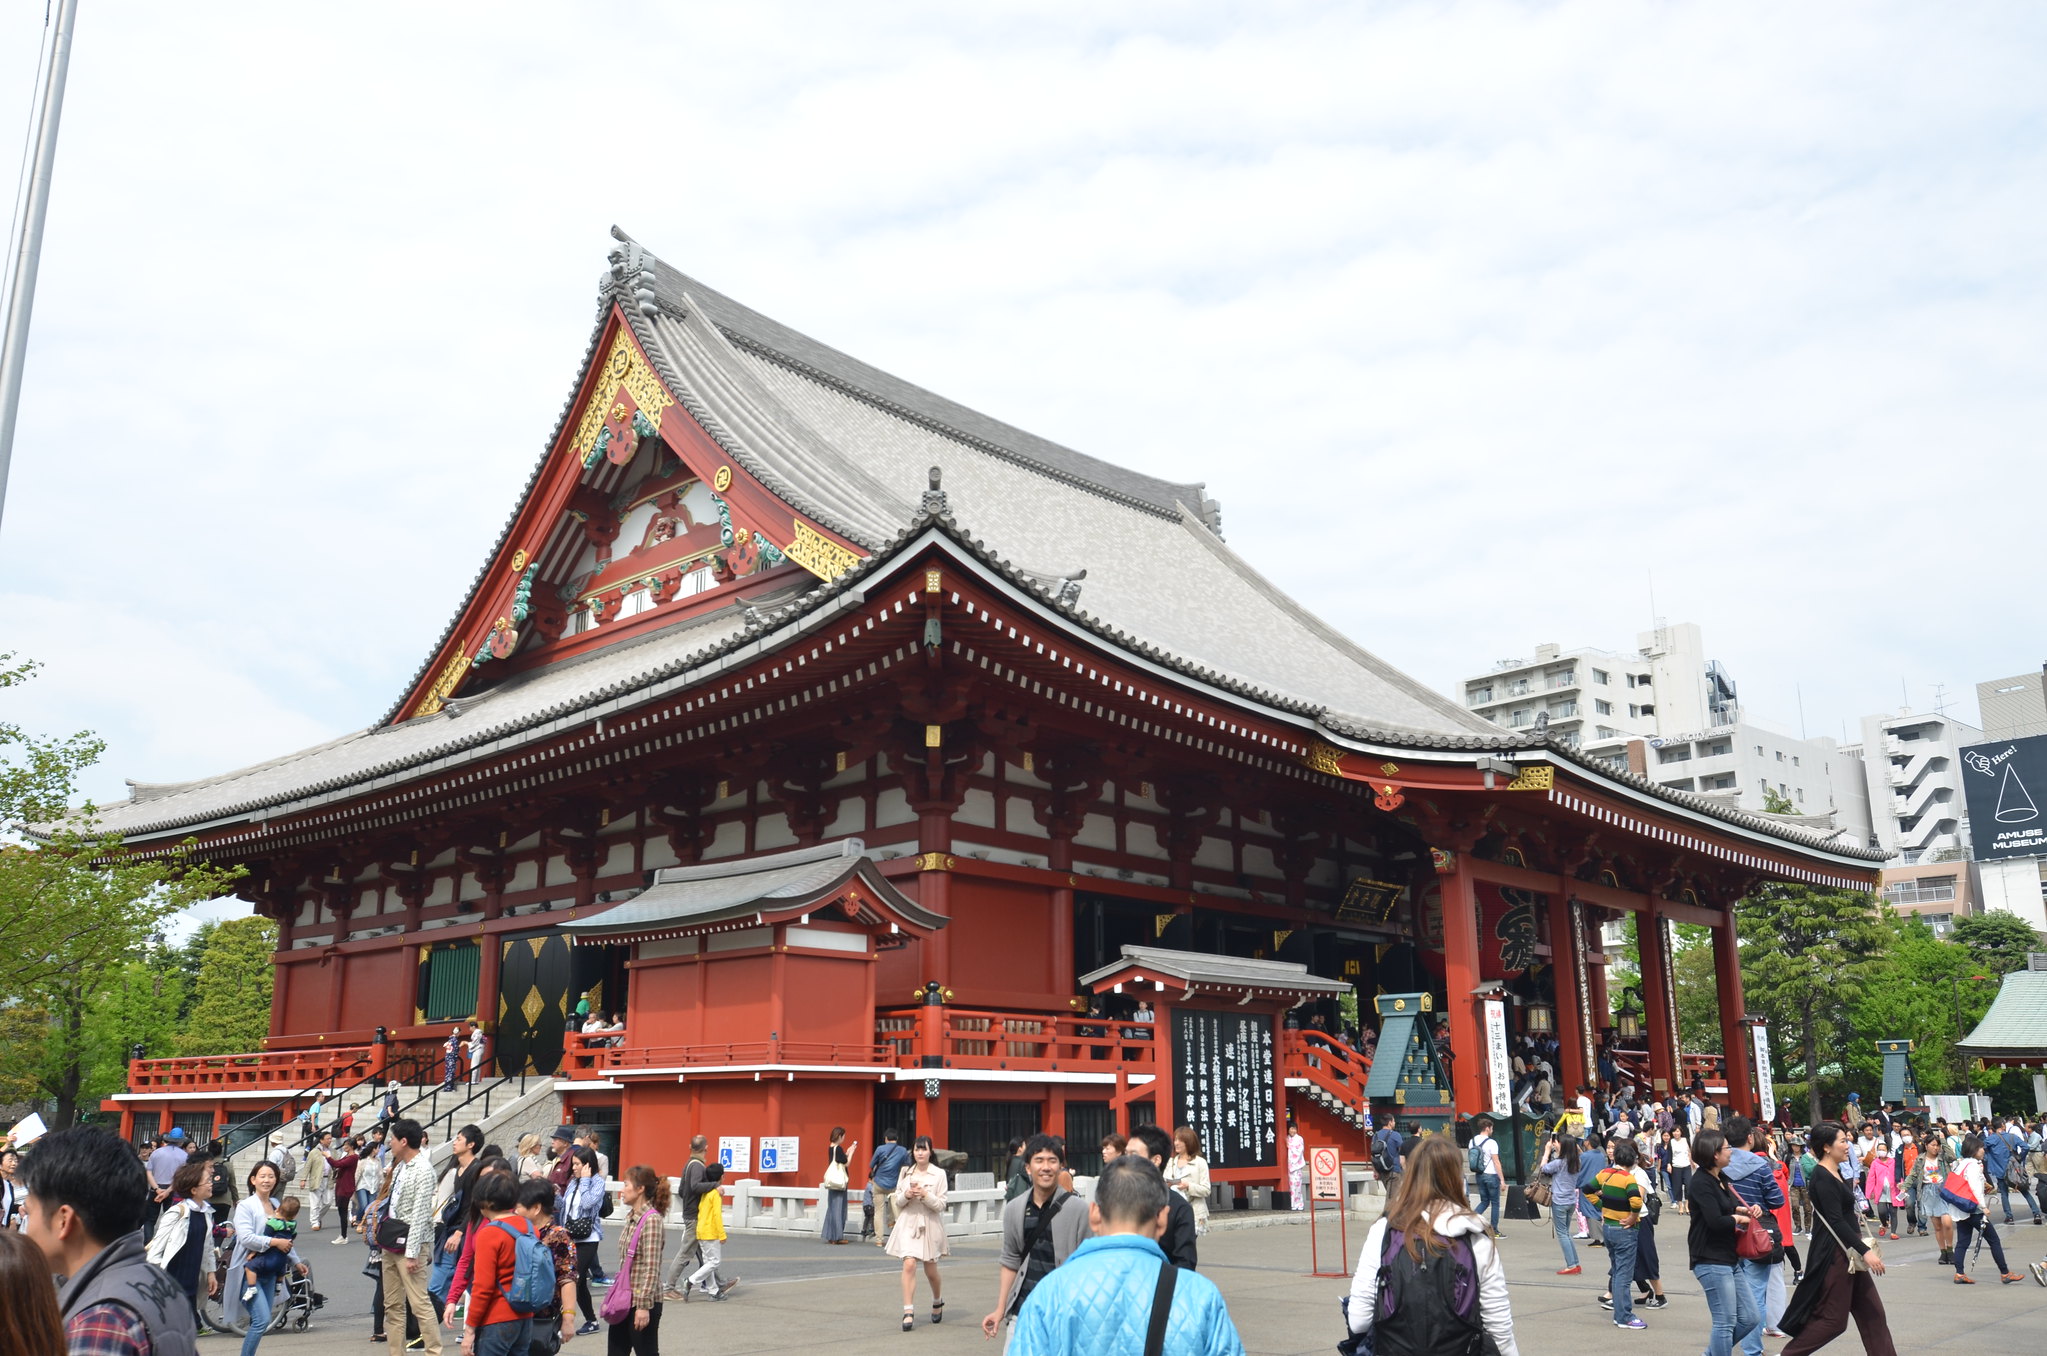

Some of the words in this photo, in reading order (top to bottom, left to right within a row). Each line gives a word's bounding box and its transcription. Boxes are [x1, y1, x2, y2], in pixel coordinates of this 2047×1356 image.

[1664, 731, 1706, 746] DYNACITY
[1991, 745, 2017, 765] Here!
[1997, 828, 2043, 840] AMUSE
[1992, 837, 2047, 850] MUSEUM
[1225, 1042, 1237, 1127] 連月法要
[1262, 1029, 1275, 1144] 本堂連日法会
